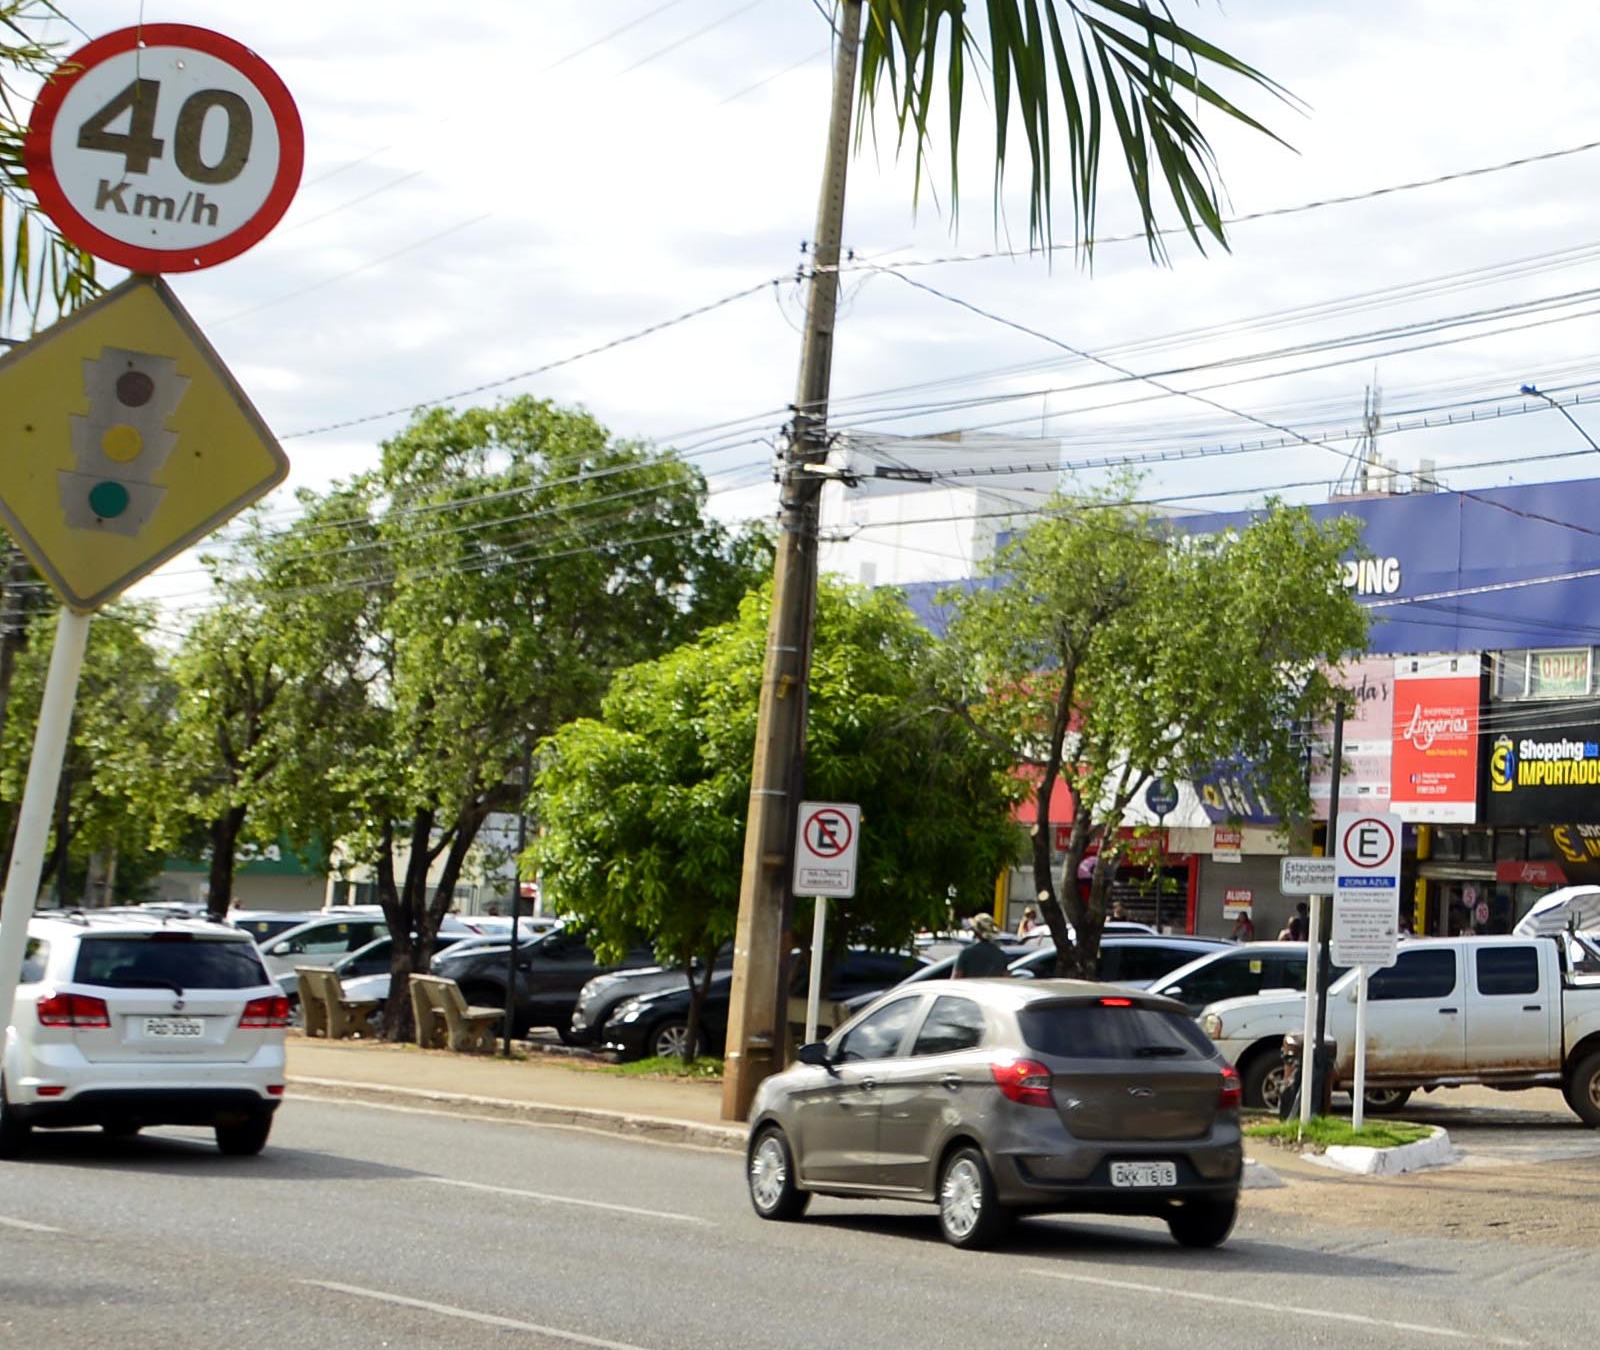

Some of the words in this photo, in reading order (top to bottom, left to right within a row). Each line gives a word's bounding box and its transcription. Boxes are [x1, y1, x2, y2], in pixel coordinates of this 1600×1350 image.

[77, 78, 253, 185] 40
[95, 179, 219, 227] Km/h
[1519, 738, 1584, 761] Shopping
[818, 818, 839, 849] E
[1359, 828, 1379, 858] E
[1344, 878, 1367, 887] ZONA
[1368, 878, 1389, 887] AZUL
